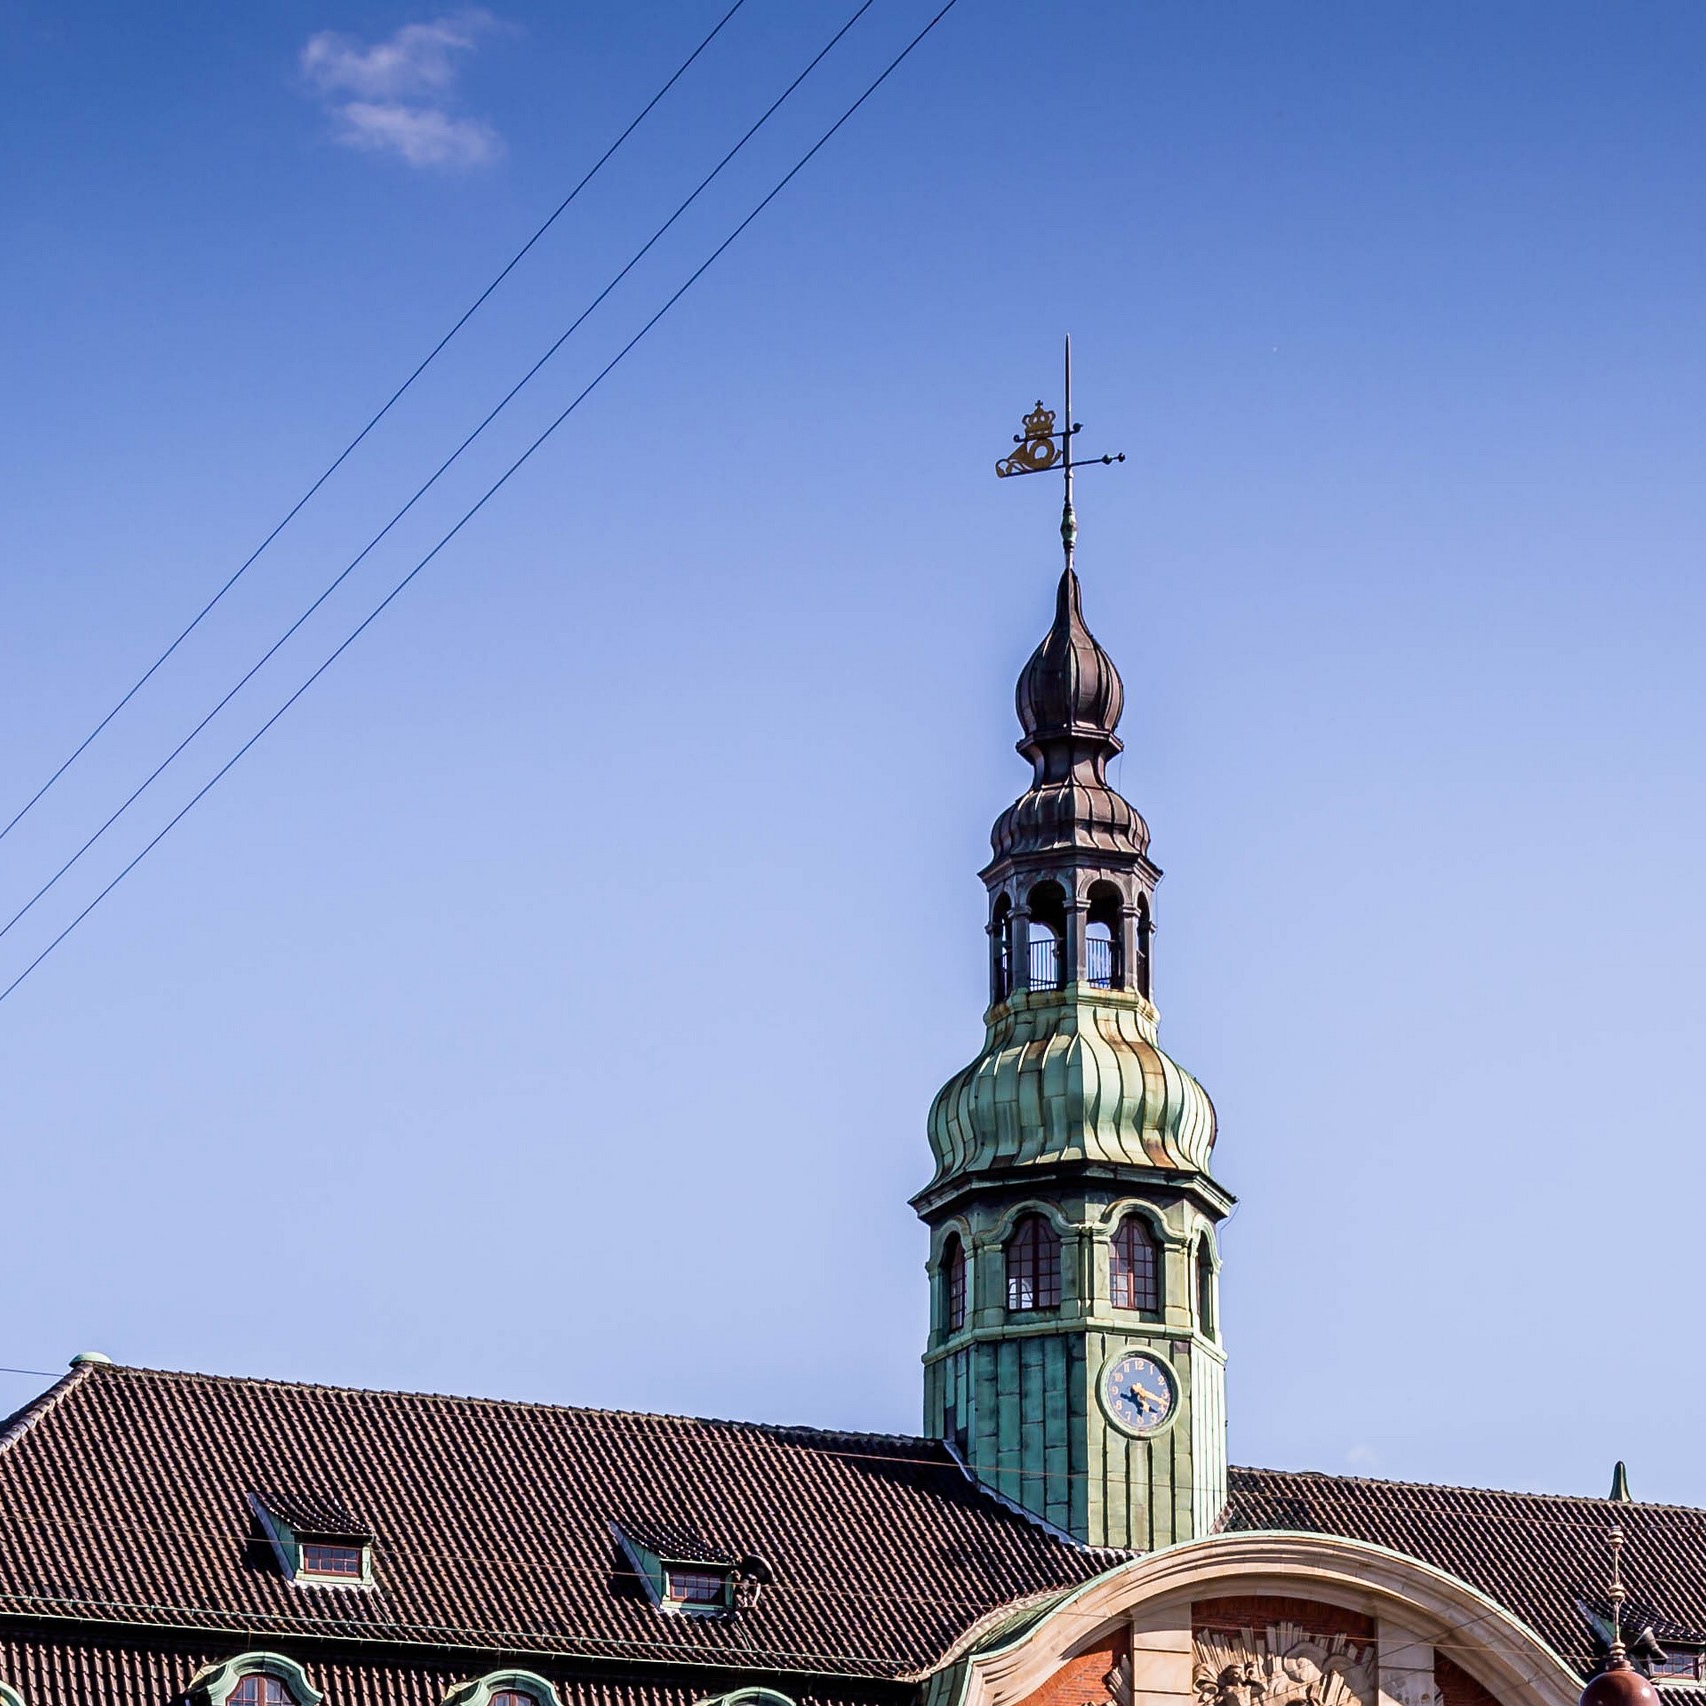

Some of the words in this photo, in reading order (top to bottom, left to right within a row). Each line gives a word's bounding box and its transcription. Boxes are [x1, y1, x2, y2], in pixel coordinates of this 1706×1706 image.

[1134, 1360, 1145, 1371] 12
[1157, 1375, 1165, 1386] 2
[1111, 1385, 1118, 1395] 9
[1115, 1400, 1122, 1410] 8
[1125, 1411, 1131, 1422] 7
